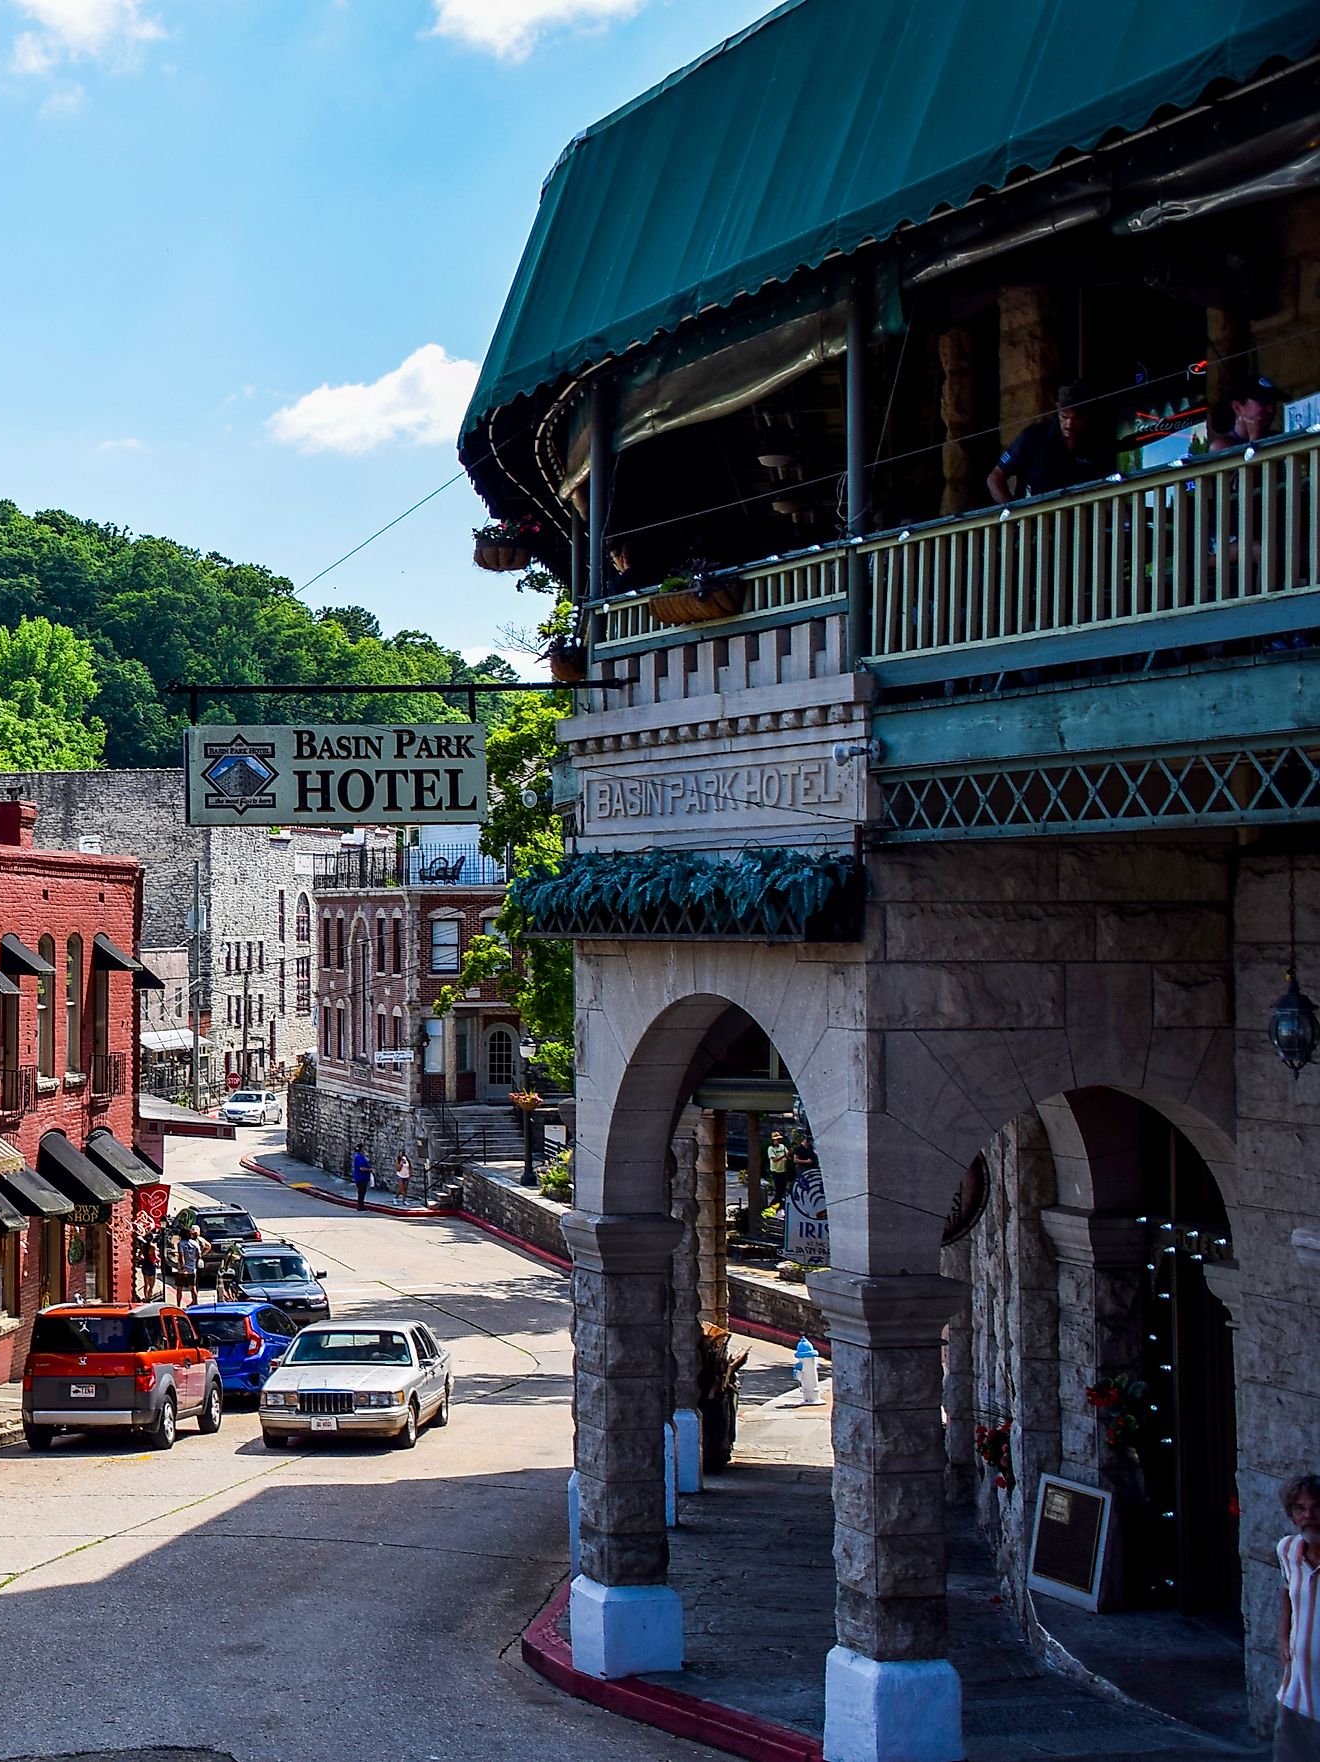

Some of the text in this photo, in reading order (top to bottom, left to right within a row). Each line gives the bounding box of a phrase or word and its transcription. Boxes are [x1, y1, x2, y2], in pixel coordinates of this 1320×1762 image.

[293, 729, 477, 760] BASIN PARK
[293, 768, 478, 813] HOTEL
[596, 762, 842, 819] BASIN PARK HOTEL
[227, 1077, 241, 1085] STOP
[67, 1213, 99, 1222] SHOP
[73, 1204, 100, 1214] OWN
